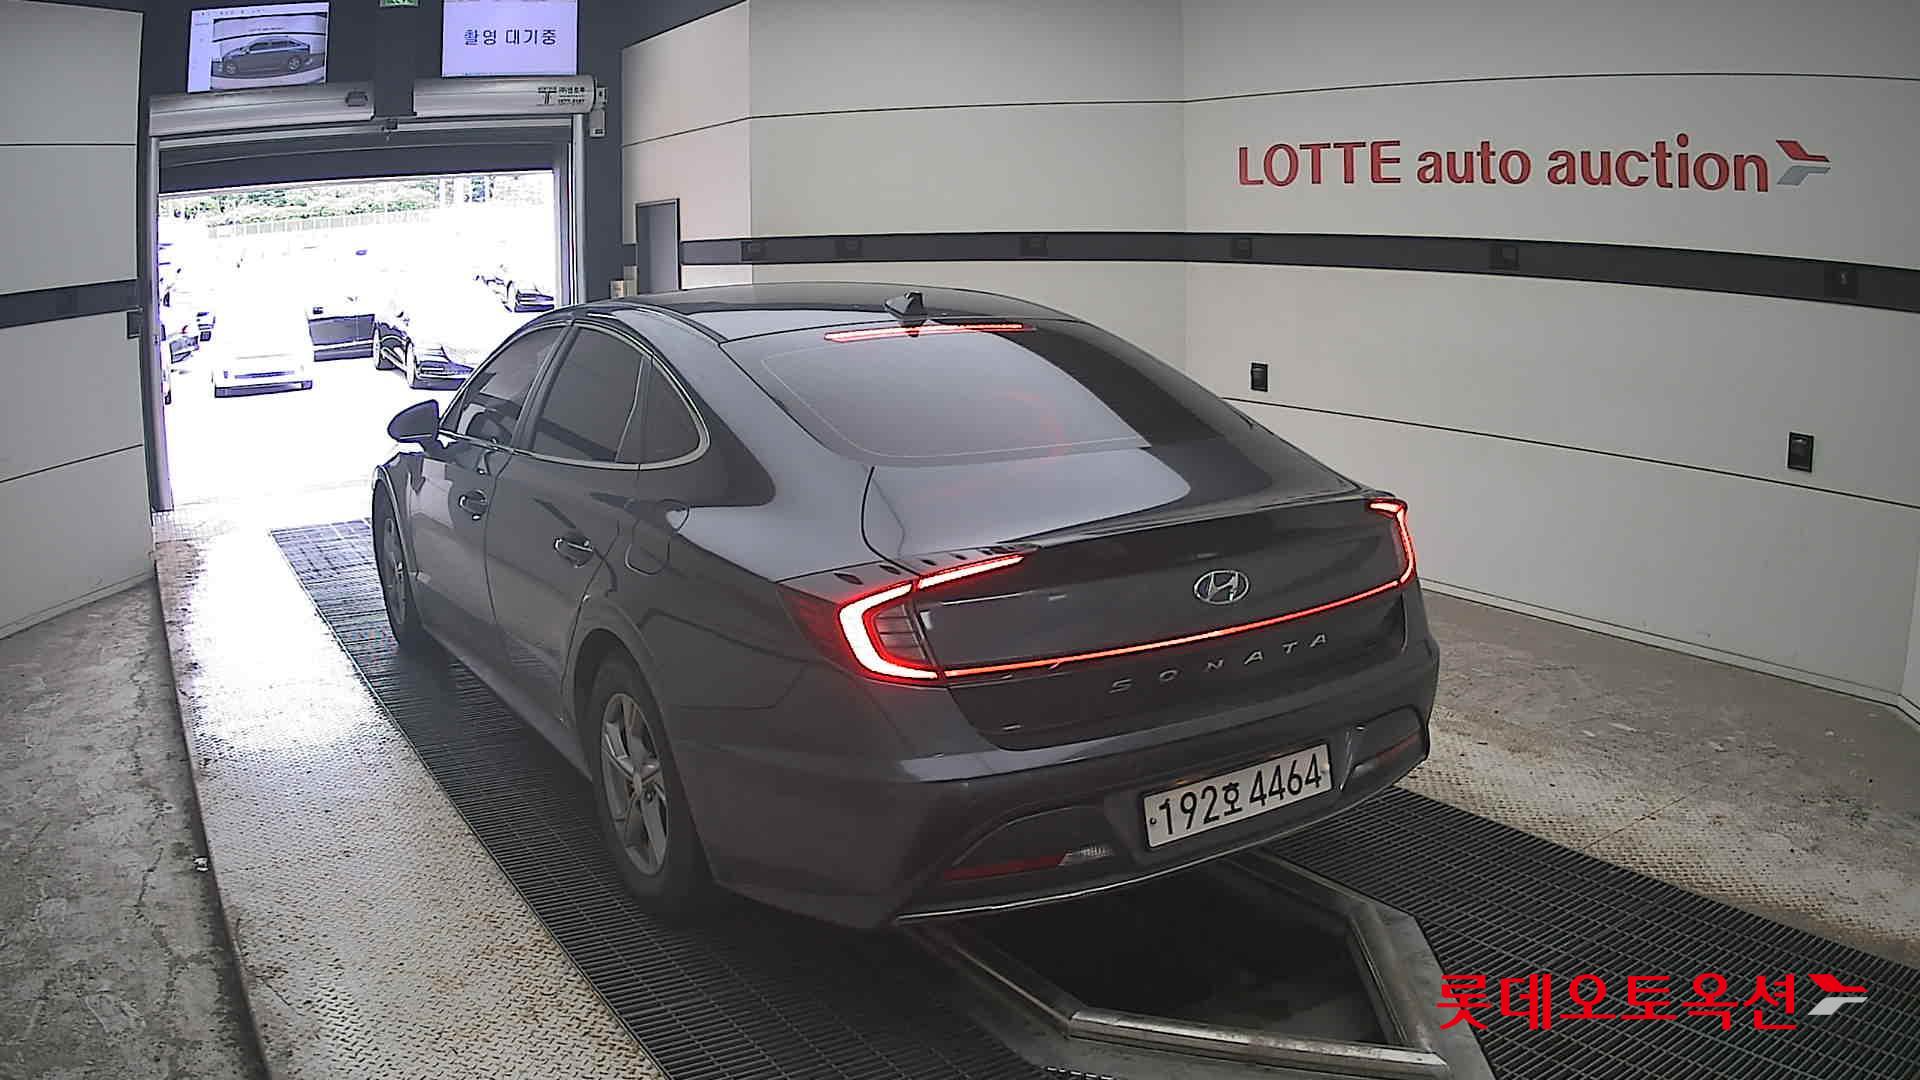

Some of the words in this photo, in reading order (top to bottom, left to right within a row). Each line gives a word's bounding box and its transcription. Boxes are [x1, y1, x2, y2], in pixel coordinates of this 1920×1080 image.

[505, 29, 556, 46] 대기중
[1238, 139, 1401, 187] LOTTE
[1416, 140, 1532, 185] auto
[1546, 133, 1769, 193] auction
[1109, 632, 1328, 694] SONATA
